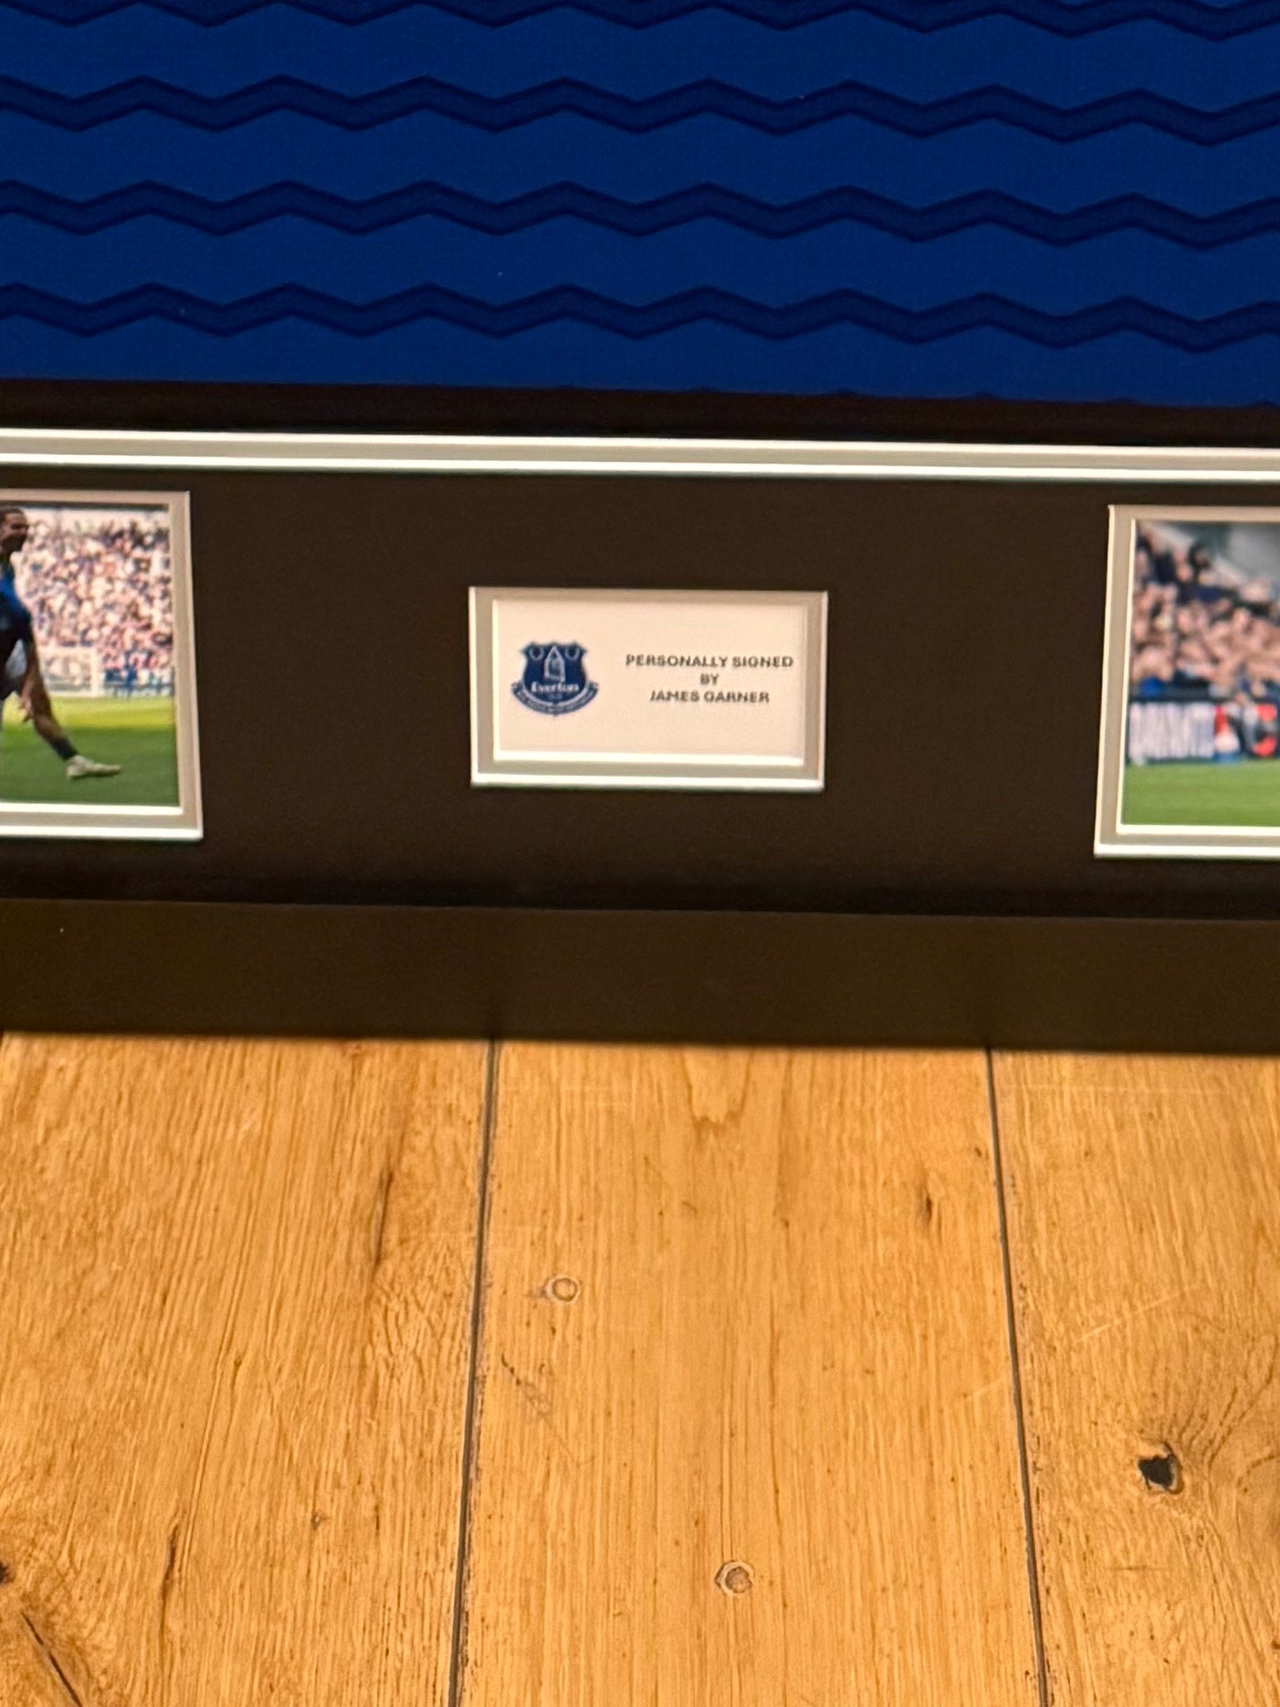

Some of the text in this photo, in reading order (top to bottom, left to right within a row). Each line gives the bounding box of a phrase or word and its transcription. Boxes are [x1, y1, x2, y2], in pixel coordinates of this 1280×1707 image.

[625, 654, 794, 669] PERSONALLY SIGNED
[699, 673, 719, 685] BY
[650, 690, 770, 704] JAMES GARNER
